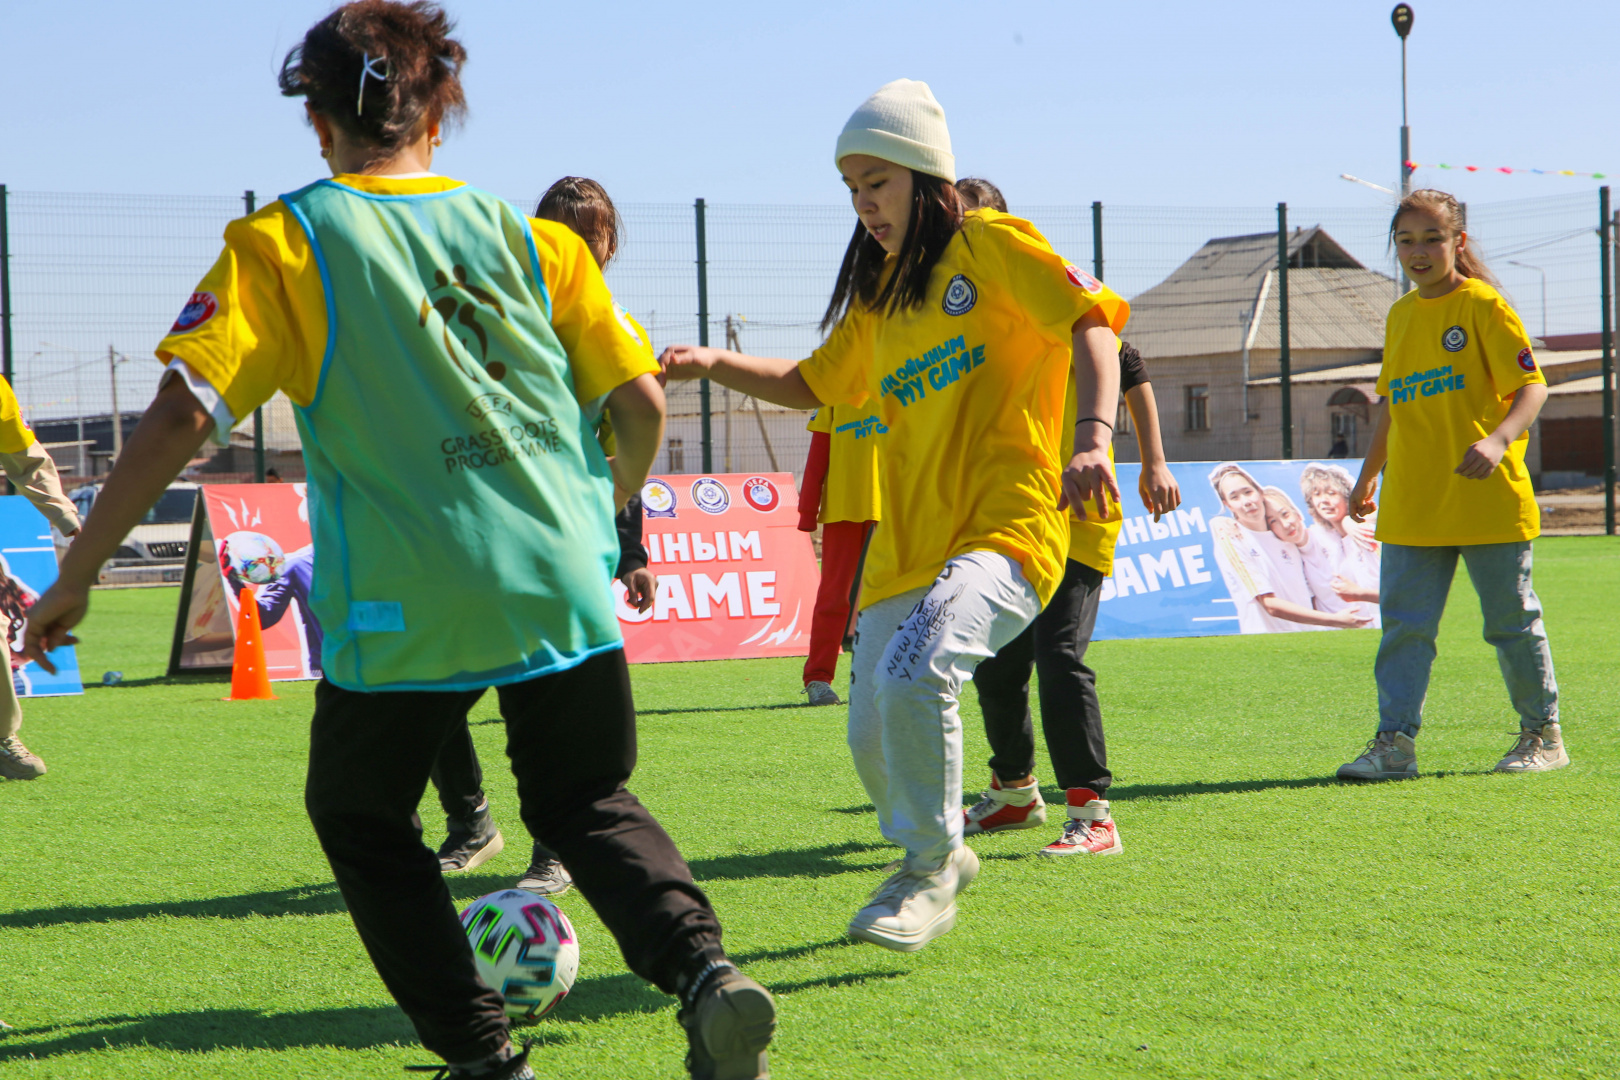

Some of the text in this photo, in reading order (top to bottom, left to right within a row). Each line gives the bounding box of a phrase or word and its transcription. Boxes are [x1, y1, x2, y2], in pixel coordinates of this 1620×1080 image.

[892, 343, 986, 407] MY GAME
[1392, 374, 1465, 405] MY GAME
[469, 397, 513, 419] UEFA
[441, 417, 559, 456] GRASSROOTS
[855, 424, 873, 440] MY
[444, 435, 562, 475] PROGRAMME
[746, 477, 770, 488] UEFA
[887, 635, 911, 676] NEW
[909, 598, 939, 635] YORK
